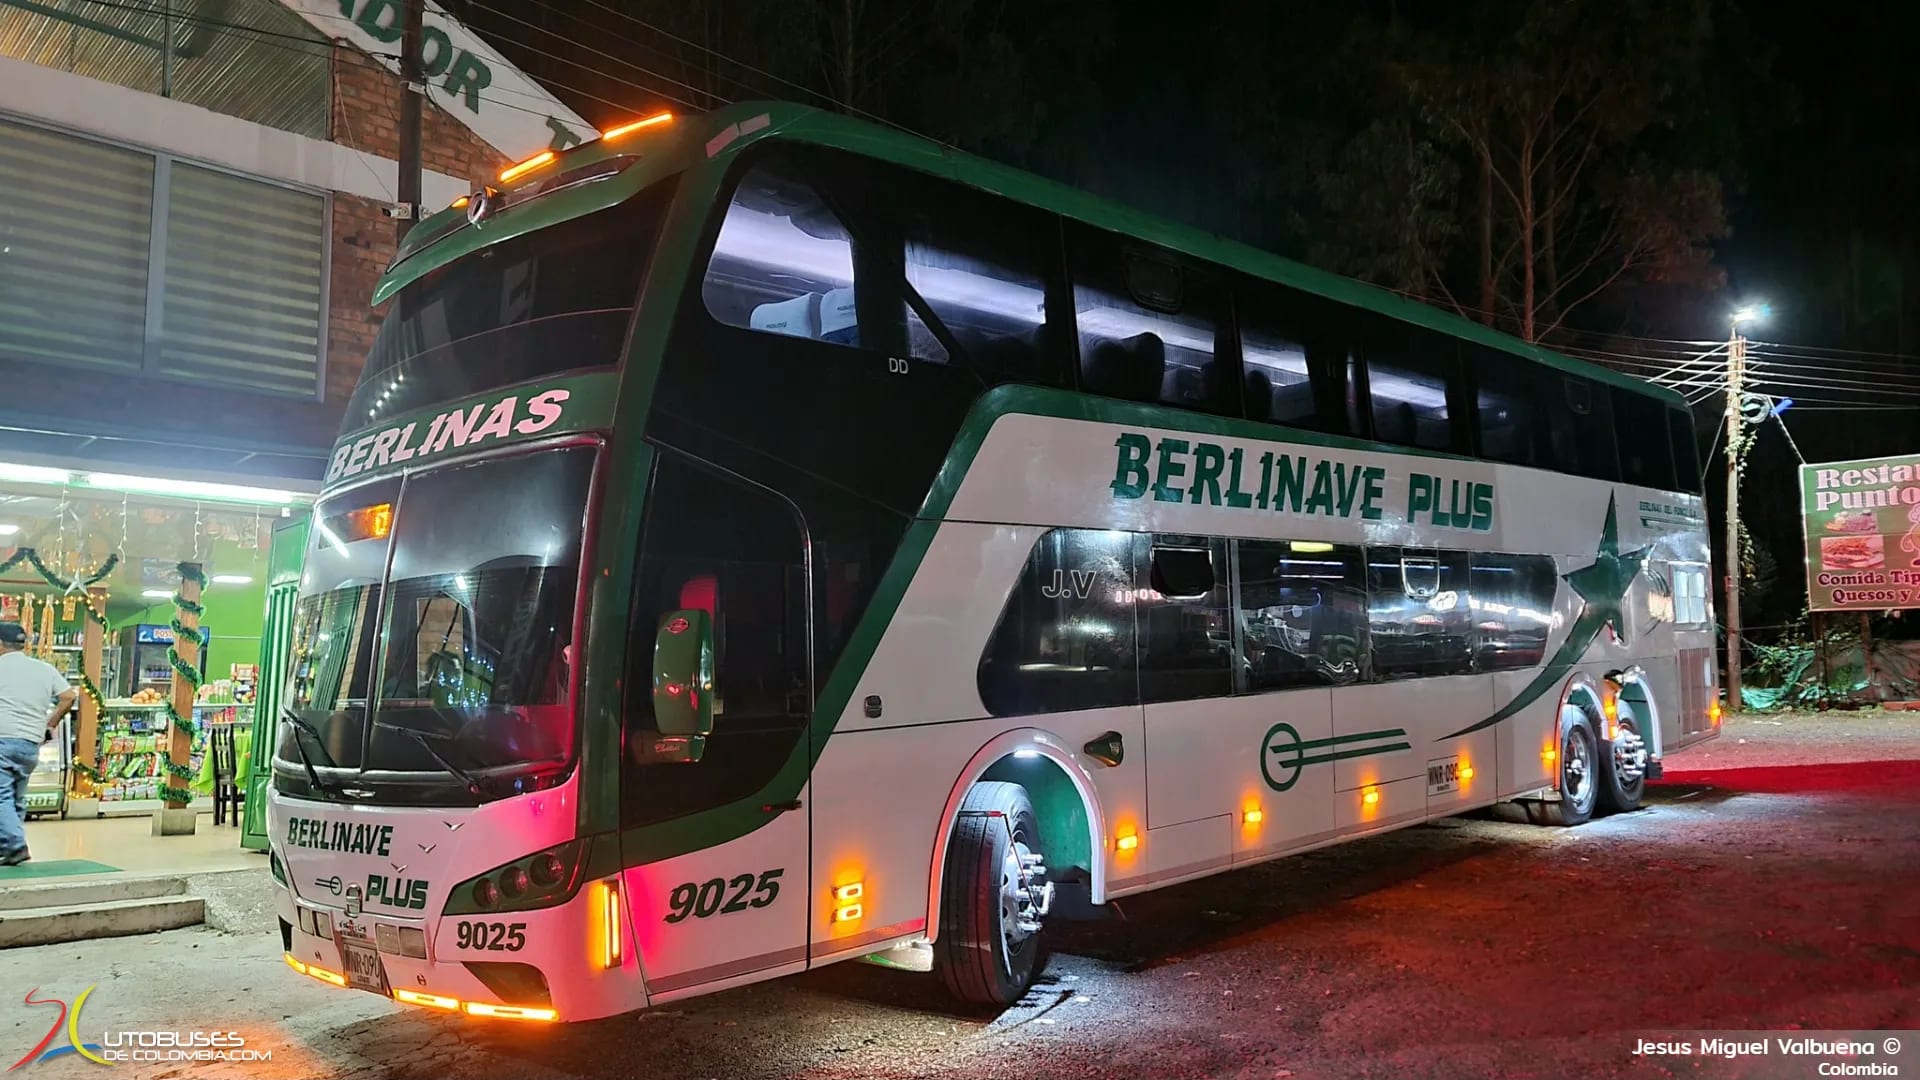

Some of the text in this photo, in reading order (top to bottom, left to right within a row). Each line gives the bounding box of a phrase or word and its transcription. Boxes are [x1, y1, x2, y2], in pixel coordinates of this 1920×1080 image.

[888, 357, 909, 374] DD
[326, 390, 570, 482] BERLINAS
[1109, 432, 1494, 530] BERLINAVE PLUS
[1816, 485, 1920, 511] Punto
[1042, 569, 1097, 599] J.V
[1818, 571, 1885, 585] Comida
[1832, 589, 1895, 604] Quesos
[1900, 589, 1911, 602] y
[287, 816, 393, 856] BERLINAVE
[365, 874, 429, 910] PLUS
[663, 868, 785, 924] 9025
[456, 921, 527, 951] 9025
